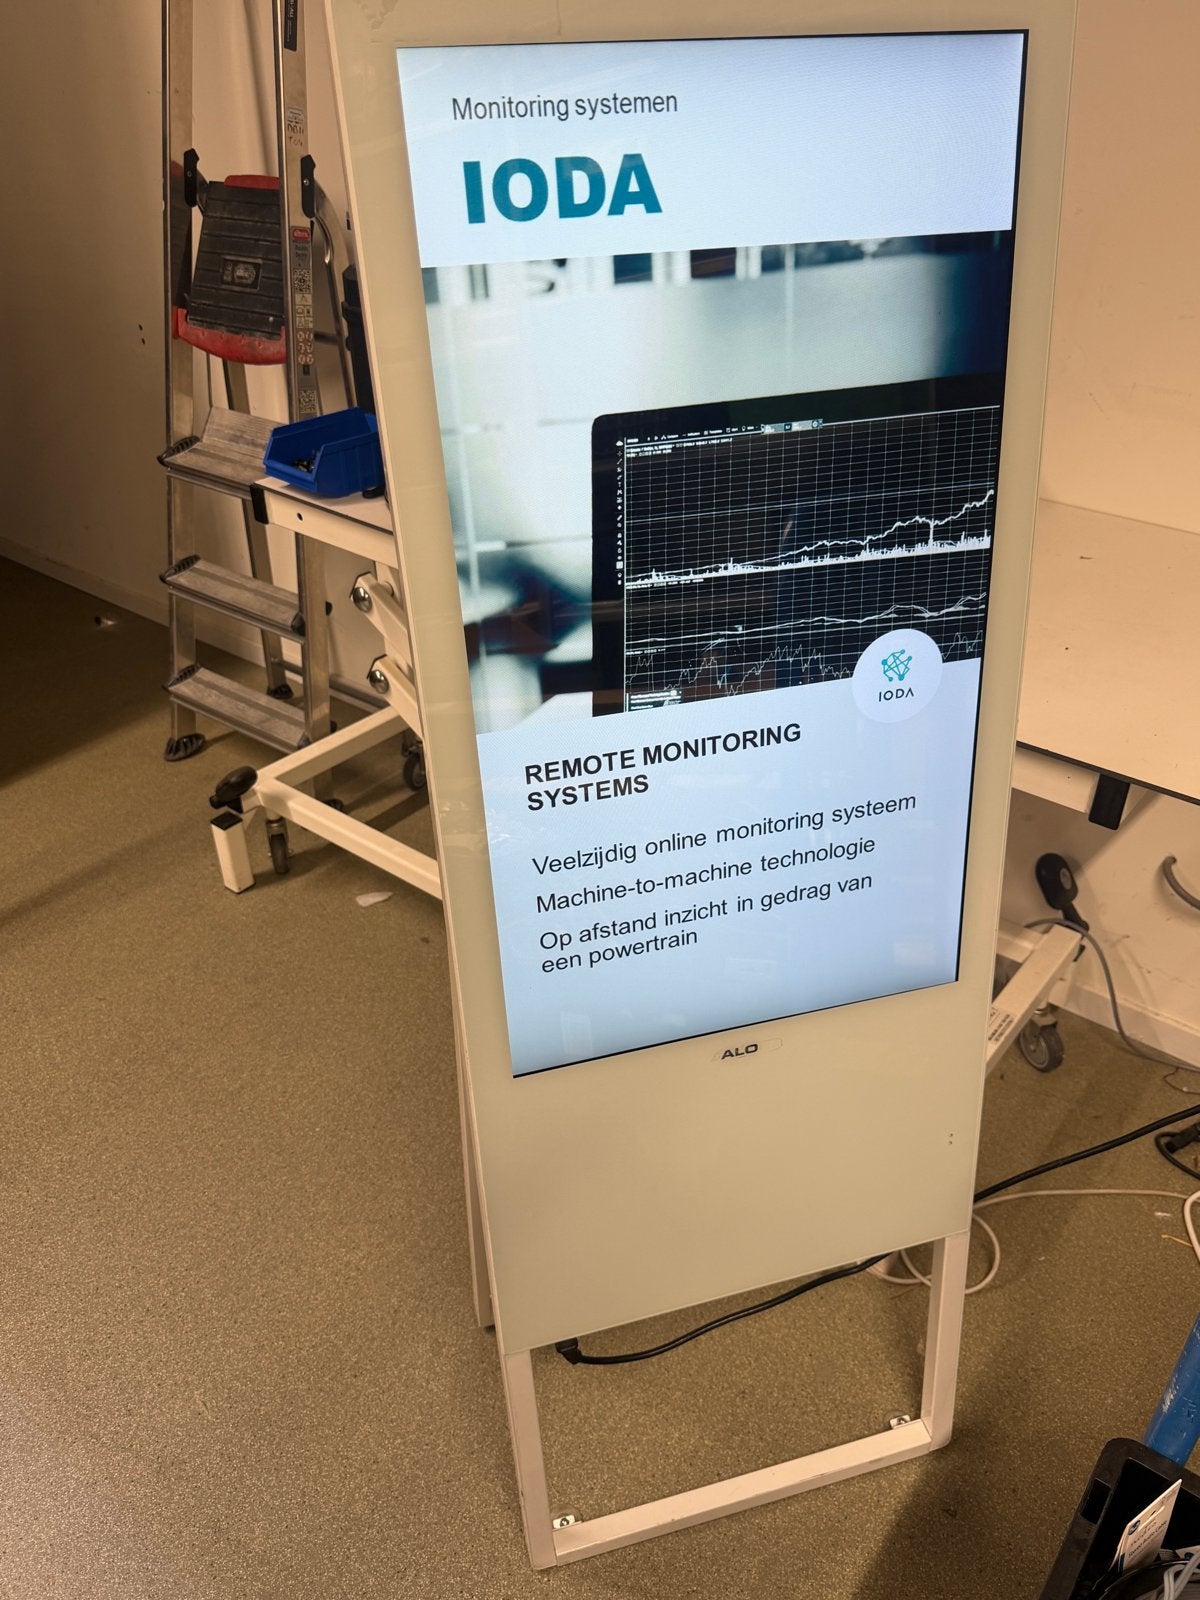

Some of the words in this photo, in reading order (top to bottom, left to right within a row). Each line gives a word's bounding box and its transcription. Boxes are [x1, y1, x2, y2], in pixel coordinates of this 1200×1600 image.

[452, 96, 570, 121] Monitoring
[575, 93, 677, 120] systemen
[464, 154, 663, 224] IODA
[879, 687, 914, 702] IODA
[525, 749, 635, 785] REMOTE
[643, 723, 801, 767] MONITORING
[528, 774, 649, 811] SYSTEMS
[532, 843, 636, 875] Veelzijdig
[645, 833, 706, 855] online
[717, 812, 823, 843] monitoring
[832, 796, 916, 825] systeem
[537, 862, 752, 913] Machine-to-machine
[760, 840, 875, 871] technologie
[540, 932, 572, 952] Op
[579, 912, 656, 942] afstand
[665, 900, 728, 926] inzicht
[738, 896, 754, 913] in
[761, 883, 830, 911] gedrag
[838, 876, 872, 893] van
[542, 955, 581, 974] een
[589, 932, 697, 968] powertrain
[721, 1043, 758, 1060] ALO
